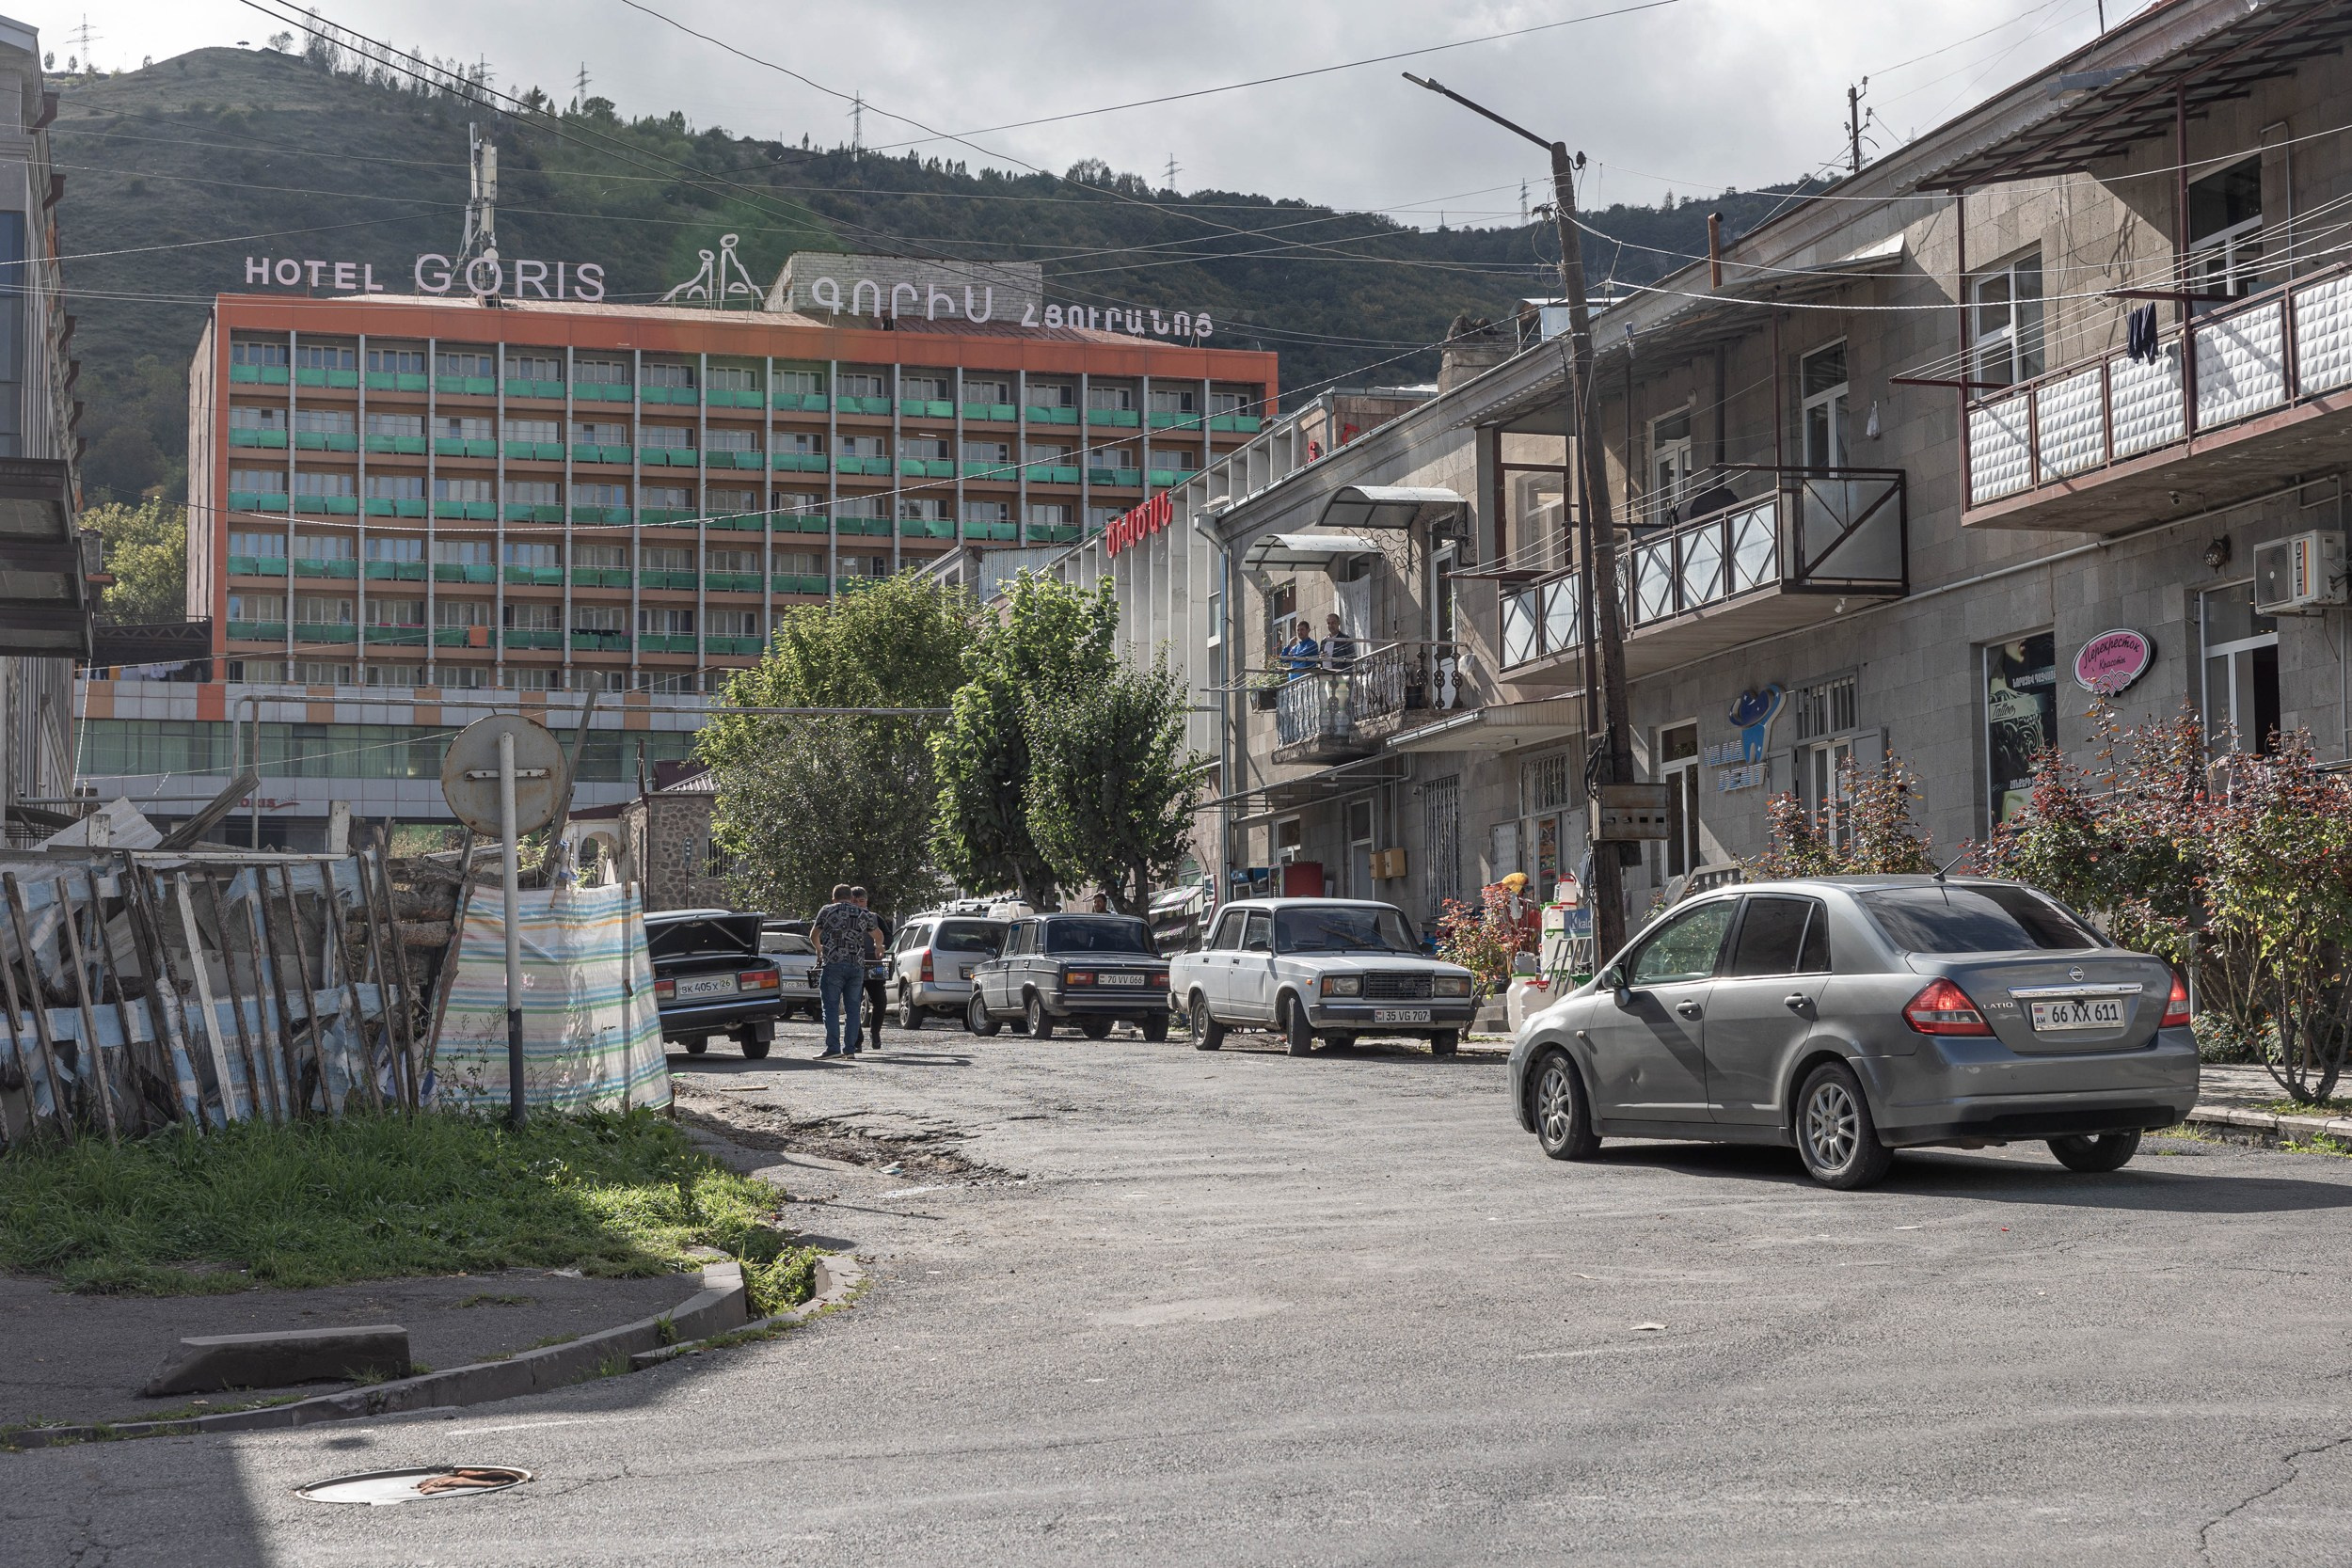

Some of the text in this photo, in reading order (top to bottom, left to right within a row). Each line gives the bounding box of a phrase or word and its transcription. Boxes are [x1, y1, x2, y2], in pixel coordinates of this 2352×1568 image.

[246, 253, 605, 302] HOTEL GORIS
[812, 276, 993, 324] ԳՈՐԻՍ
[2082, 636, 2140, 670] Перекресток
[2098, 656, 2126, 673] Красоты
[1993, 702, 2015, 719] Tattoo
[1703, 739, 1743, 768] YANA
[1717, 762, 1767, 792] DENT
[694, 981, 712, 992] 405
[721, 979, 731, 988] 26
[1107, 975, 1117, 984] 70
[1129, 975, 1143, 985] 066
[1983, 1002, 2013, 1010] LATIO
[2052, 1004, 2120, 1023] 66 XX 611
[1386, 1011, 1396, 1022] 35
[1399, 1011, 1411, 1022] VG
[1412, 1010, 1428, 1022] 707
[2036, 1016, 2046, 1024] AM
